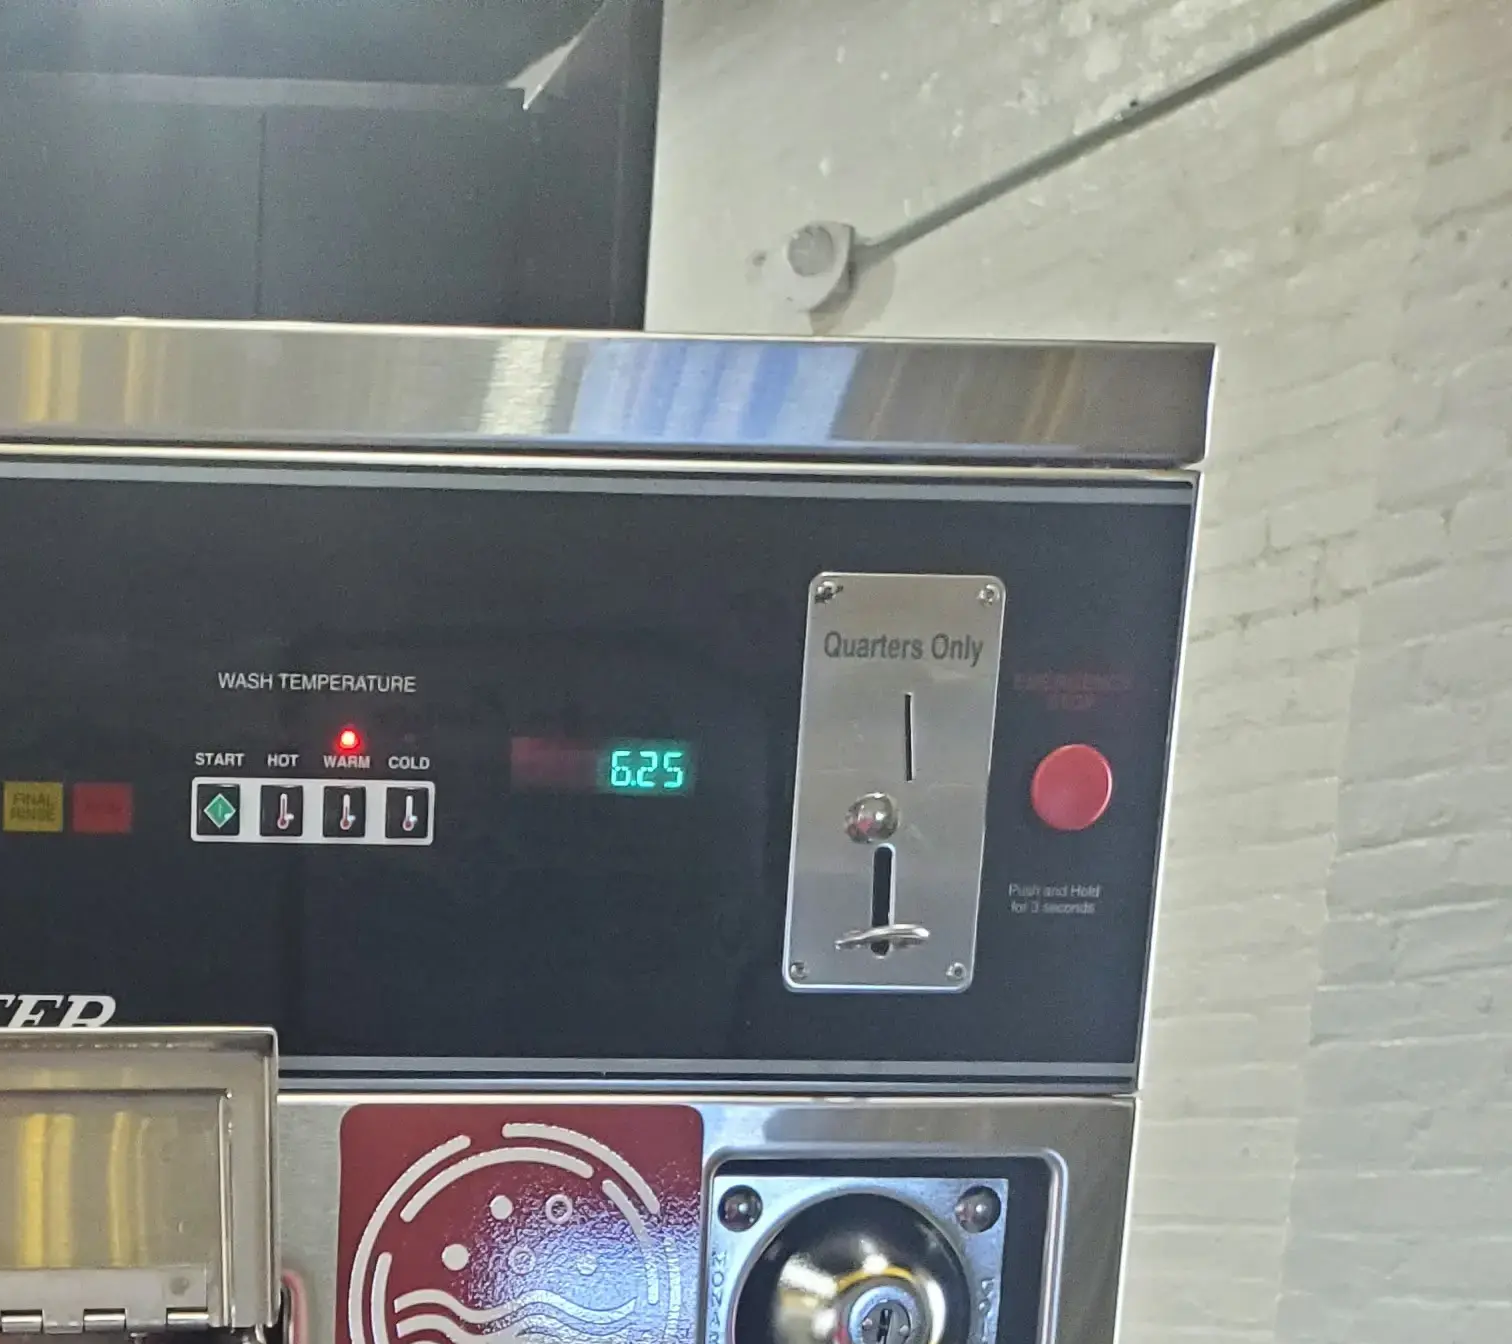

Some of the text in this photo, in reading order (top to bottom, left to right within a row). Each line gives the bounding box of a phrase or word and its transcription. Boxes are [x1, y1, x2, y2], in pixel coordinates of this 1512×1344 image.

[824, 631, 984, 668] Quarters Only
[218, 672, 417, 693] WASH TEMPERATURE
[195, 752, 430, 771] START HOT WARM COLD
[1071, 885, 1100, 898] Hold
